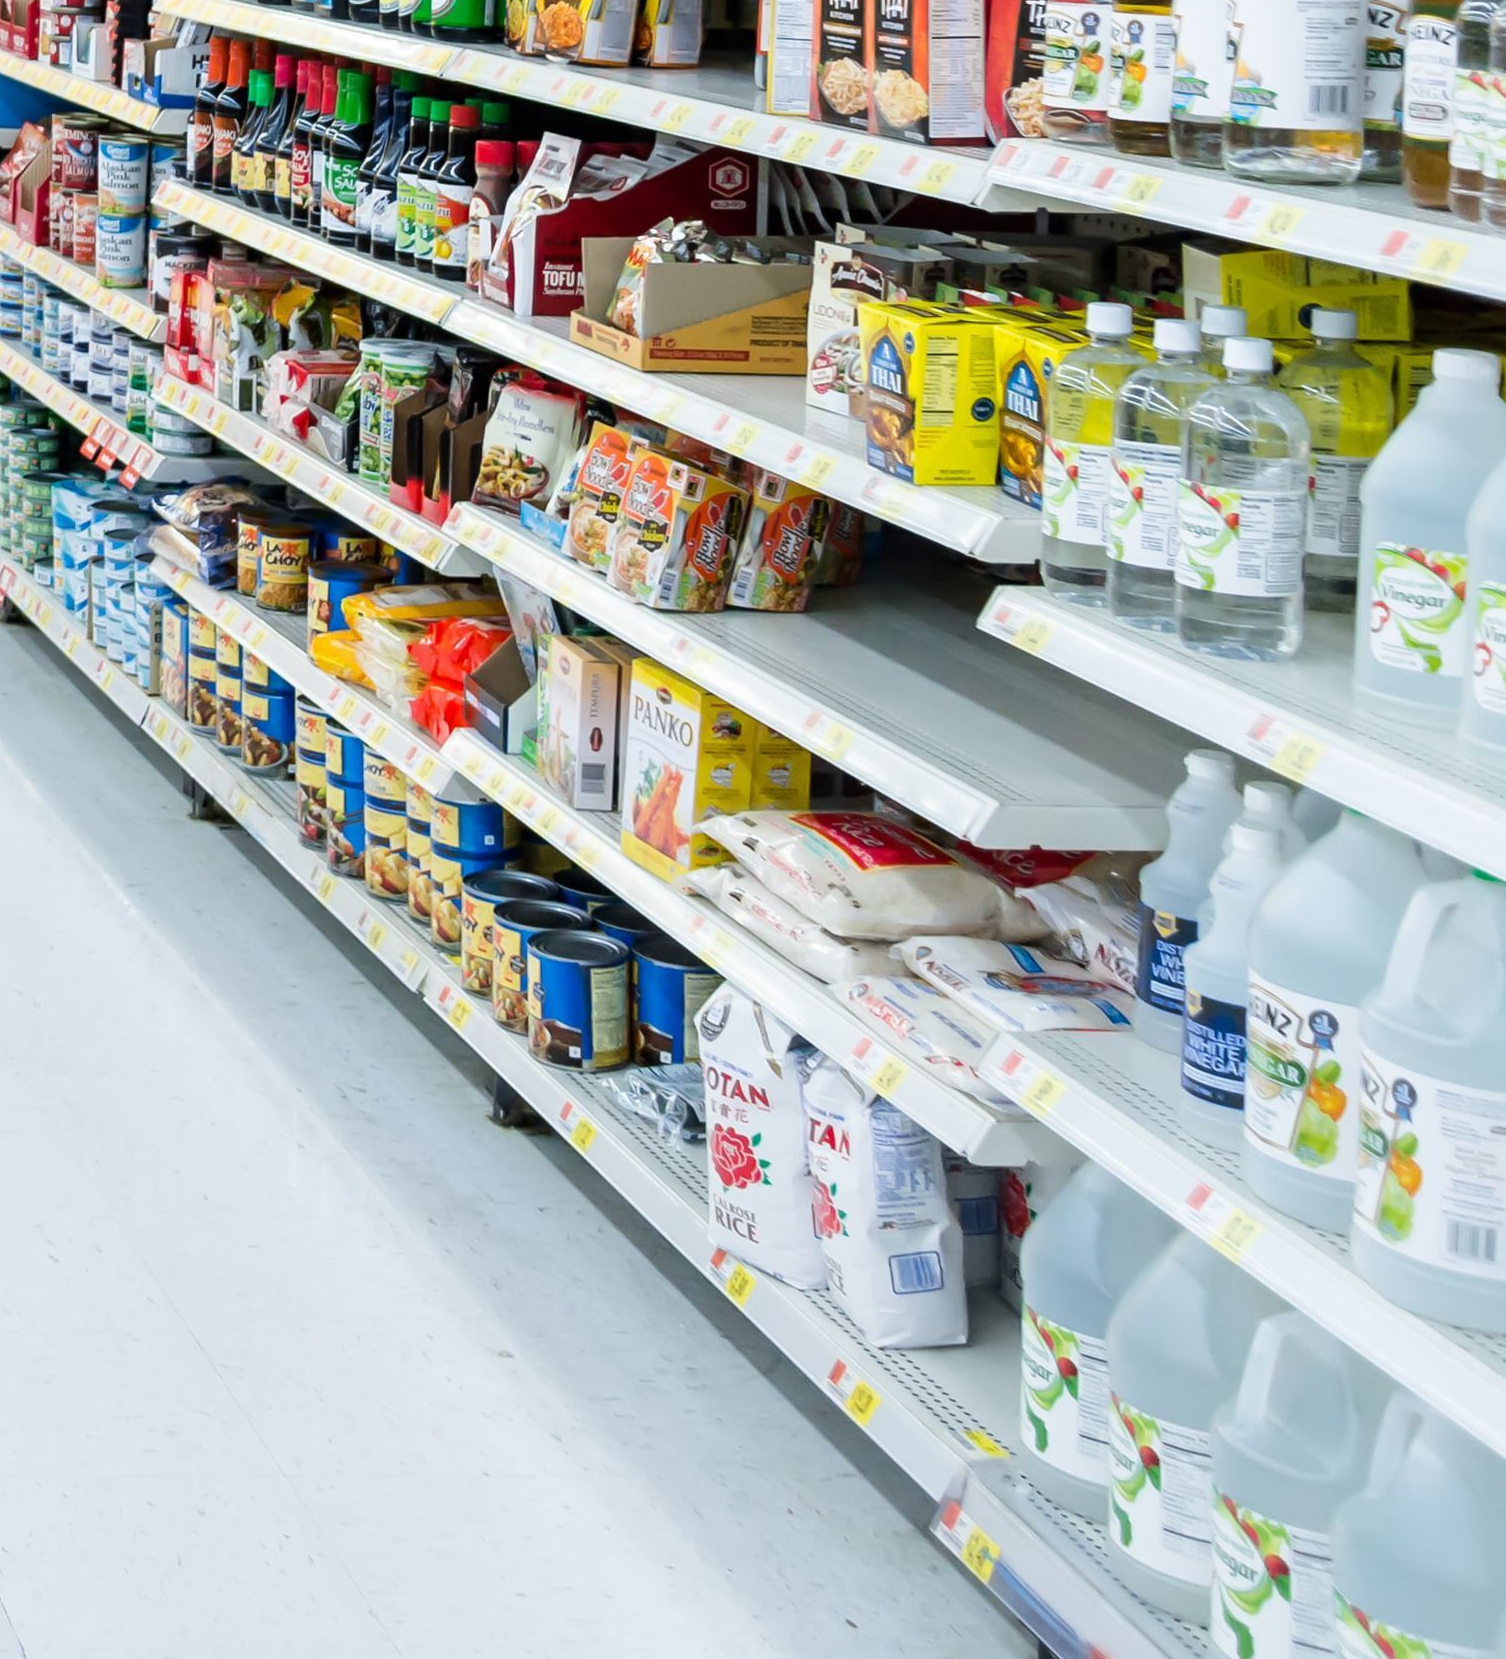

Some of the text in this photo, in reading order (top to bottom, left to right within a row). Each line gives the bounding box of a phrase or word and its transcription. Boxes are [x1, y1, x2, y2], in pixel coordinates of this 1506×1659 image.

[100, 163, 141, 174] Alaskan
[107, 172, 132, 182] Pink
[100, 243, 121, 253] Pink
[542, 271, 574, 288] TOFU
[871, 366, 902, 394] THAI
[1007, 390, 1038, 422] THAI
[589, 449, 612, 474] Bowl
[584, 465, 615, 490] Noodle
[633, 473, 656, 496] Bowl
[265, 543, 281, 557] LA
[695, 526, 720, 571] Bowl
[706, 516, 726, 573] Noodle
[773, 527, 797, 571] Bowl
[784, 516, 810, 574] Noodle
[265, 553, 302, 568] CHOY
[589, 672, 602, 719] TEMPURA
[633, 696, 695, 748] PANKO
[1187, 1033, 1240, 1061] WHITE
[707, 1066, 770, 1112] OTAN
[715, 1208, 759, 1244] RICE
